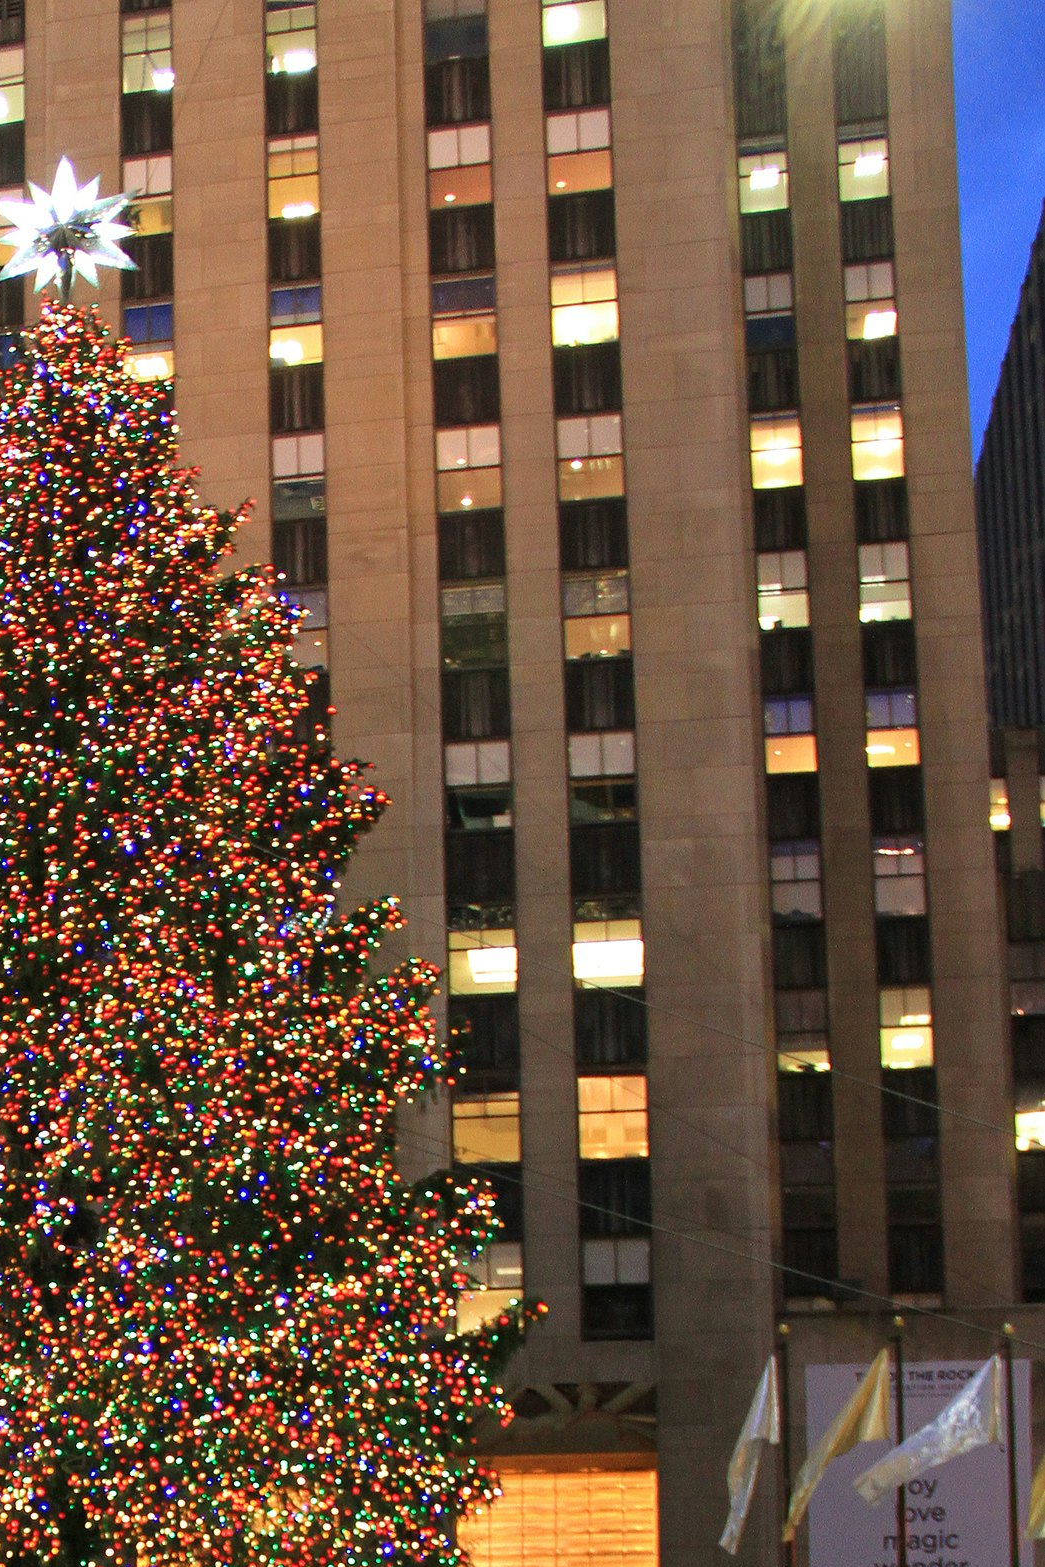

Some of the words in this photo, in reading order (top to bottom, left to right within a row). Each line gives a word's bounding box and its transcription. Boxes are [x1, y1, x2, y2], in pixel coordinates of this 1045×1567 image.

[909, 1370, 933, 1382] THE
[907, 1478, 938, 1499] oy
[905, 1504, 946, 1523] ove
